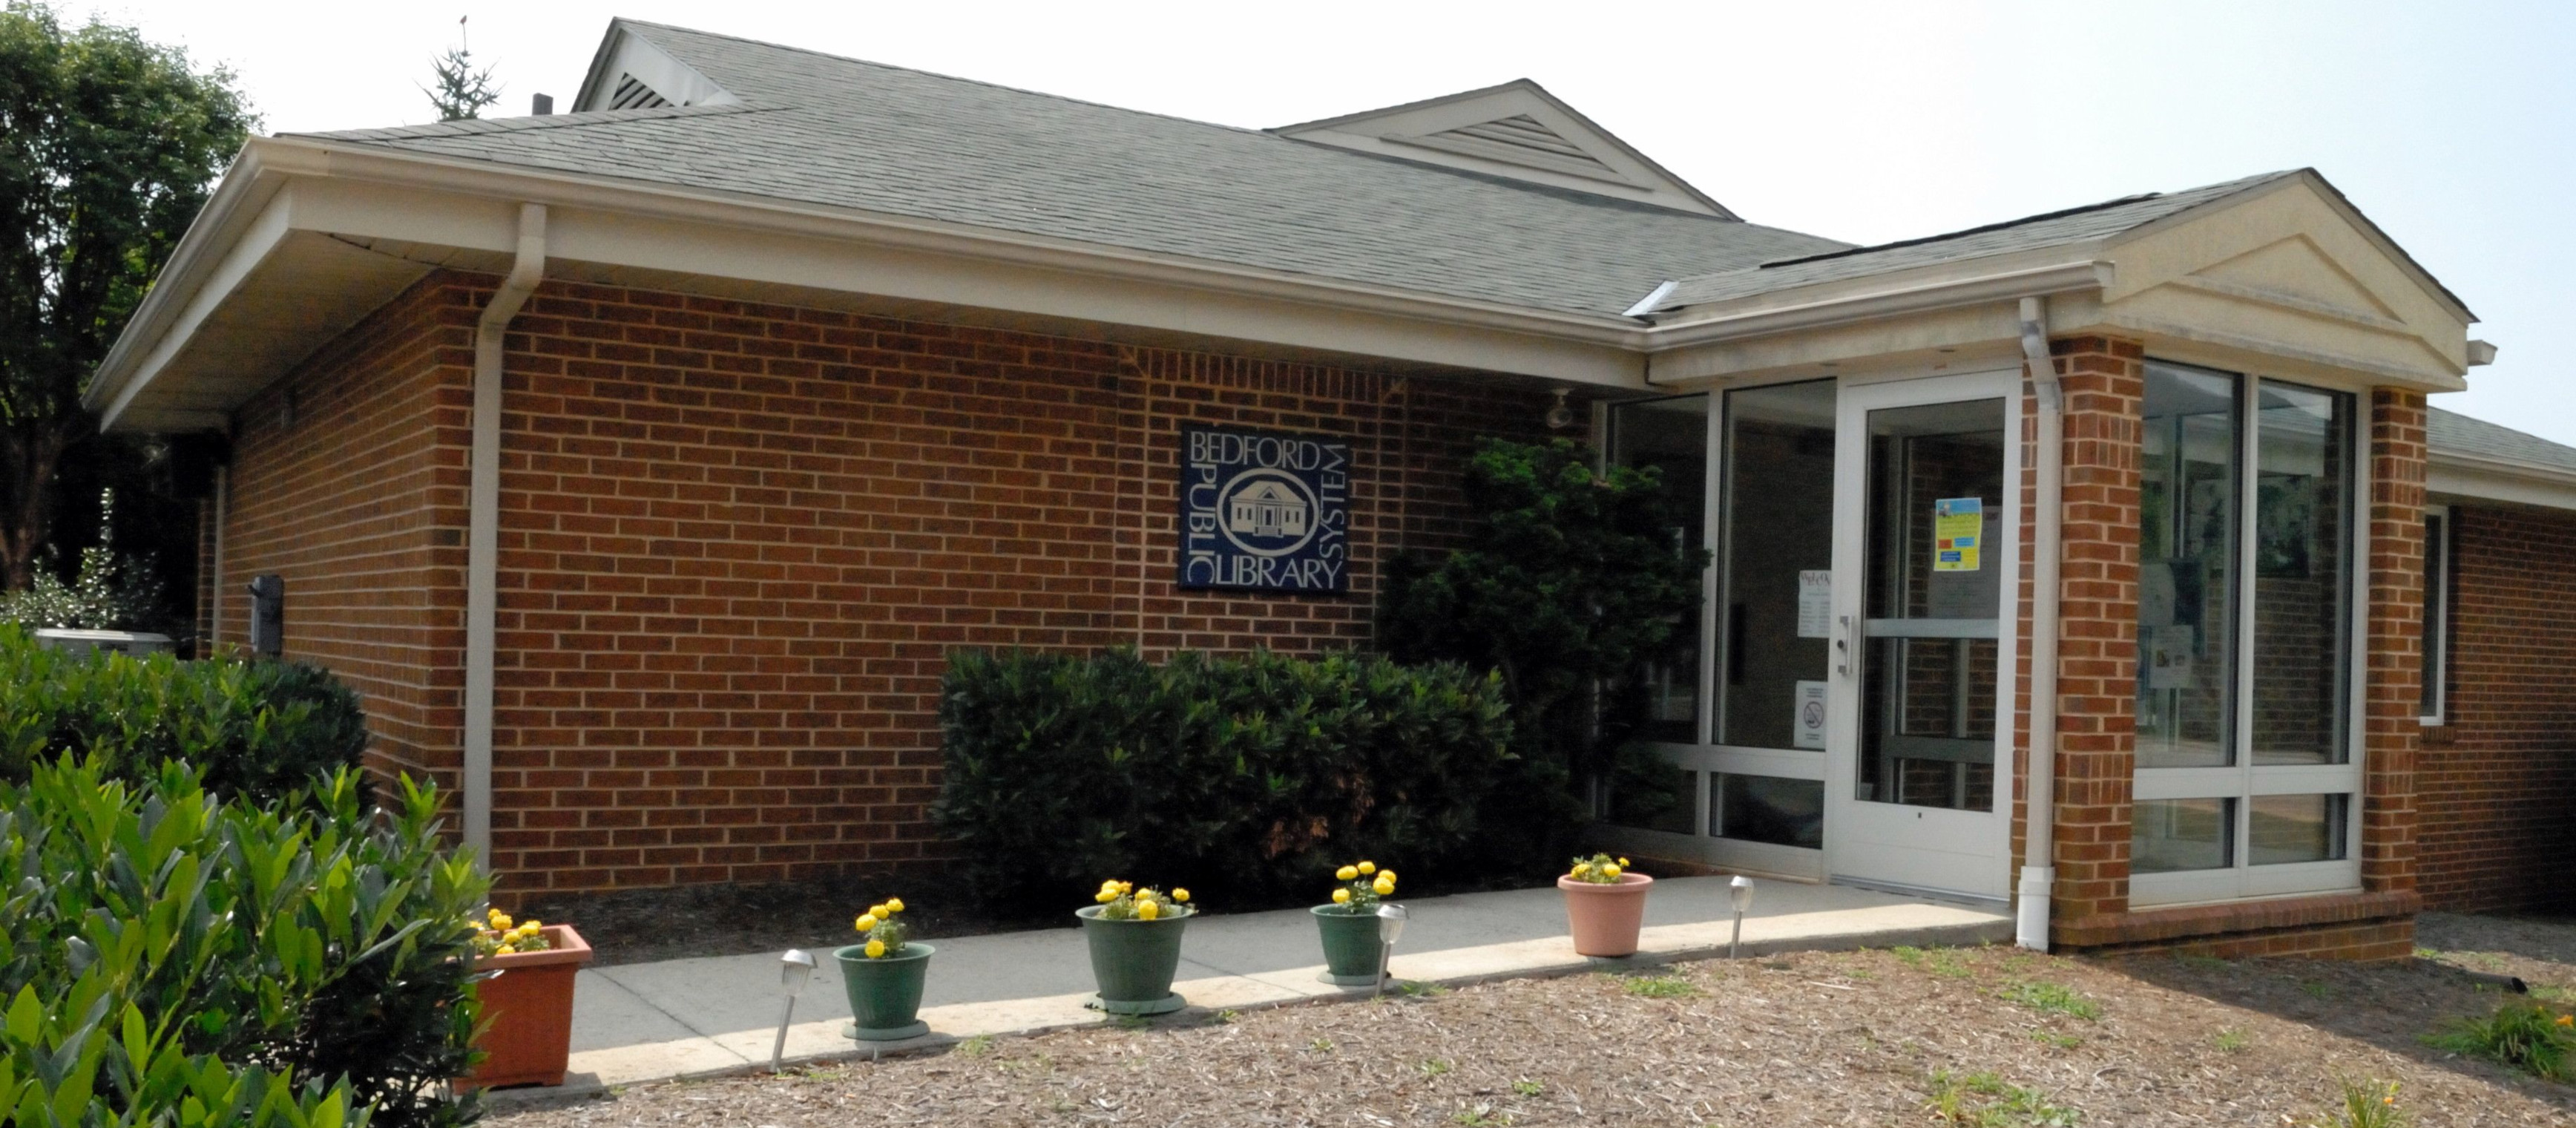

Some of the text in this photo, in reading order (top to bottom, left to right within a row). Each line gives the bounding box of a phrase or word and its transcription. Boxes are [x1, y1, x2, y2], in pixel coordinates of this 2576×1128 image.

[1190, 431, 1320, 470] BEDFORD
[1189, 463, 1217, 583] PUBLIC
[1319, 445, 1346, 560] SYSTEM
[1216, 555, 1342, 588] LIBRARY
